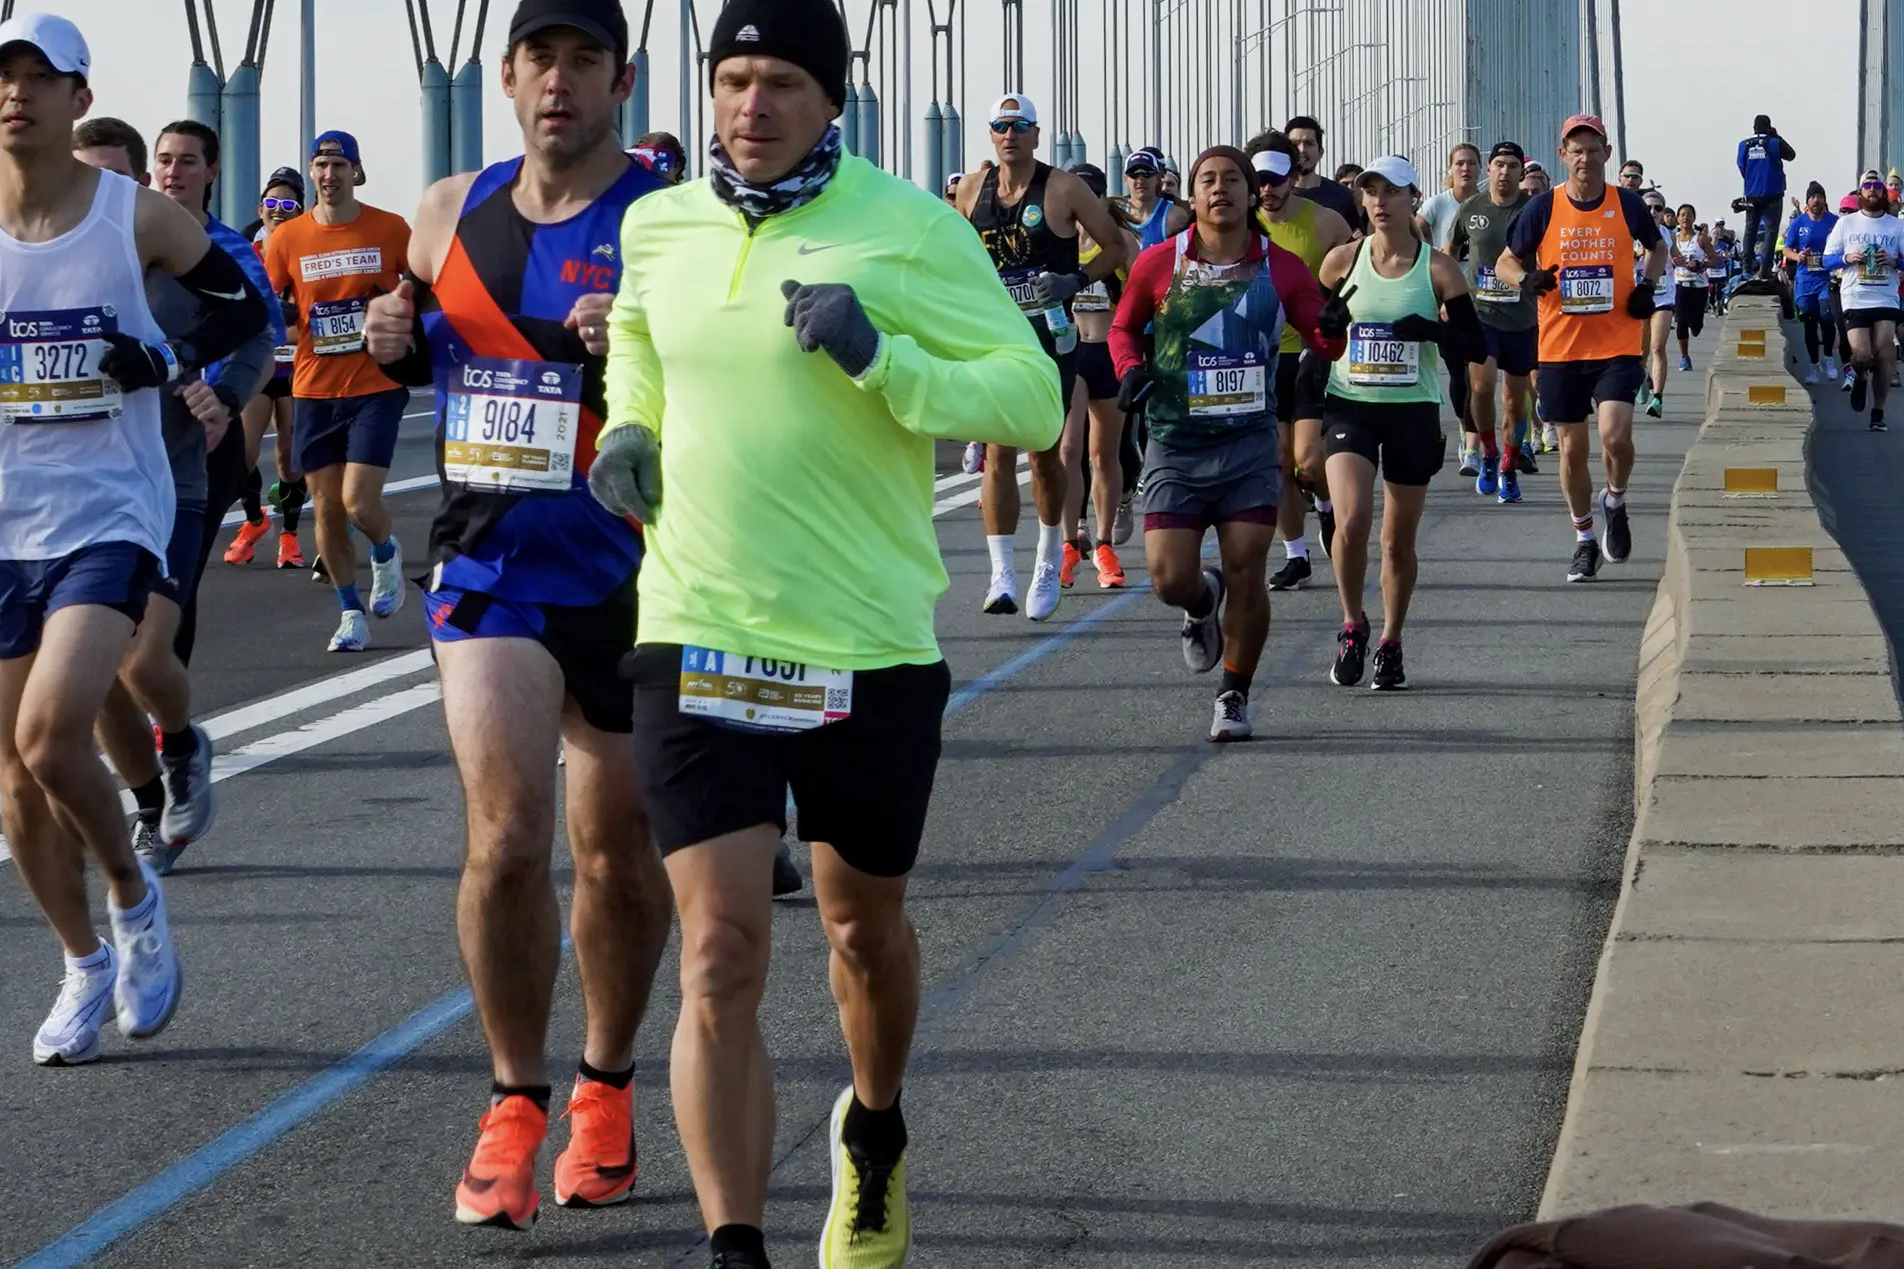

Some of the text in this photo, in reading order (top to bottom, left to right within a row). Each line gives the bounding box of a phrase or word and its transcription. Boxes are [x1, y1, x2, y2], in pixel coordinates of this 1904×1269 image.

[1560, 227, 1601, 238] EVERY
[1559, 238, 1616, 249] MOTHER
[304, 258, 342, 273] FRED'S
[345, 254, 378, 267] TEAM
[1560, 250, 1614, 262] COUNTS
[560, 258, 613, 289] NYC
[1565, 269, 1580, 278] tcs
[1006, 282, 1036, 302] 0701
[1576, 280, 1601, 296] 8072
[315, 305, 331, 316] tcs
[9, 319, 38, 338] tcs
[81, 326, 102, 334] TATA
[330, 314, 356, 334] 8154
[1359, 326, 1375, 338] tcs
[35, 343, 89, 380] 3272
[1198, 355, 1217, 367] tcs
[1368, 342, 1405, 363] 10462
[463, 364, 493, 388] tcs
[1216, 370, 1245, 392] 8197
[537, 385, 562, 395] TATA
[482, 399, 537, 444] 9184
[556, 412, 568, 442] 2021
[704, 650, 718, 673] A
